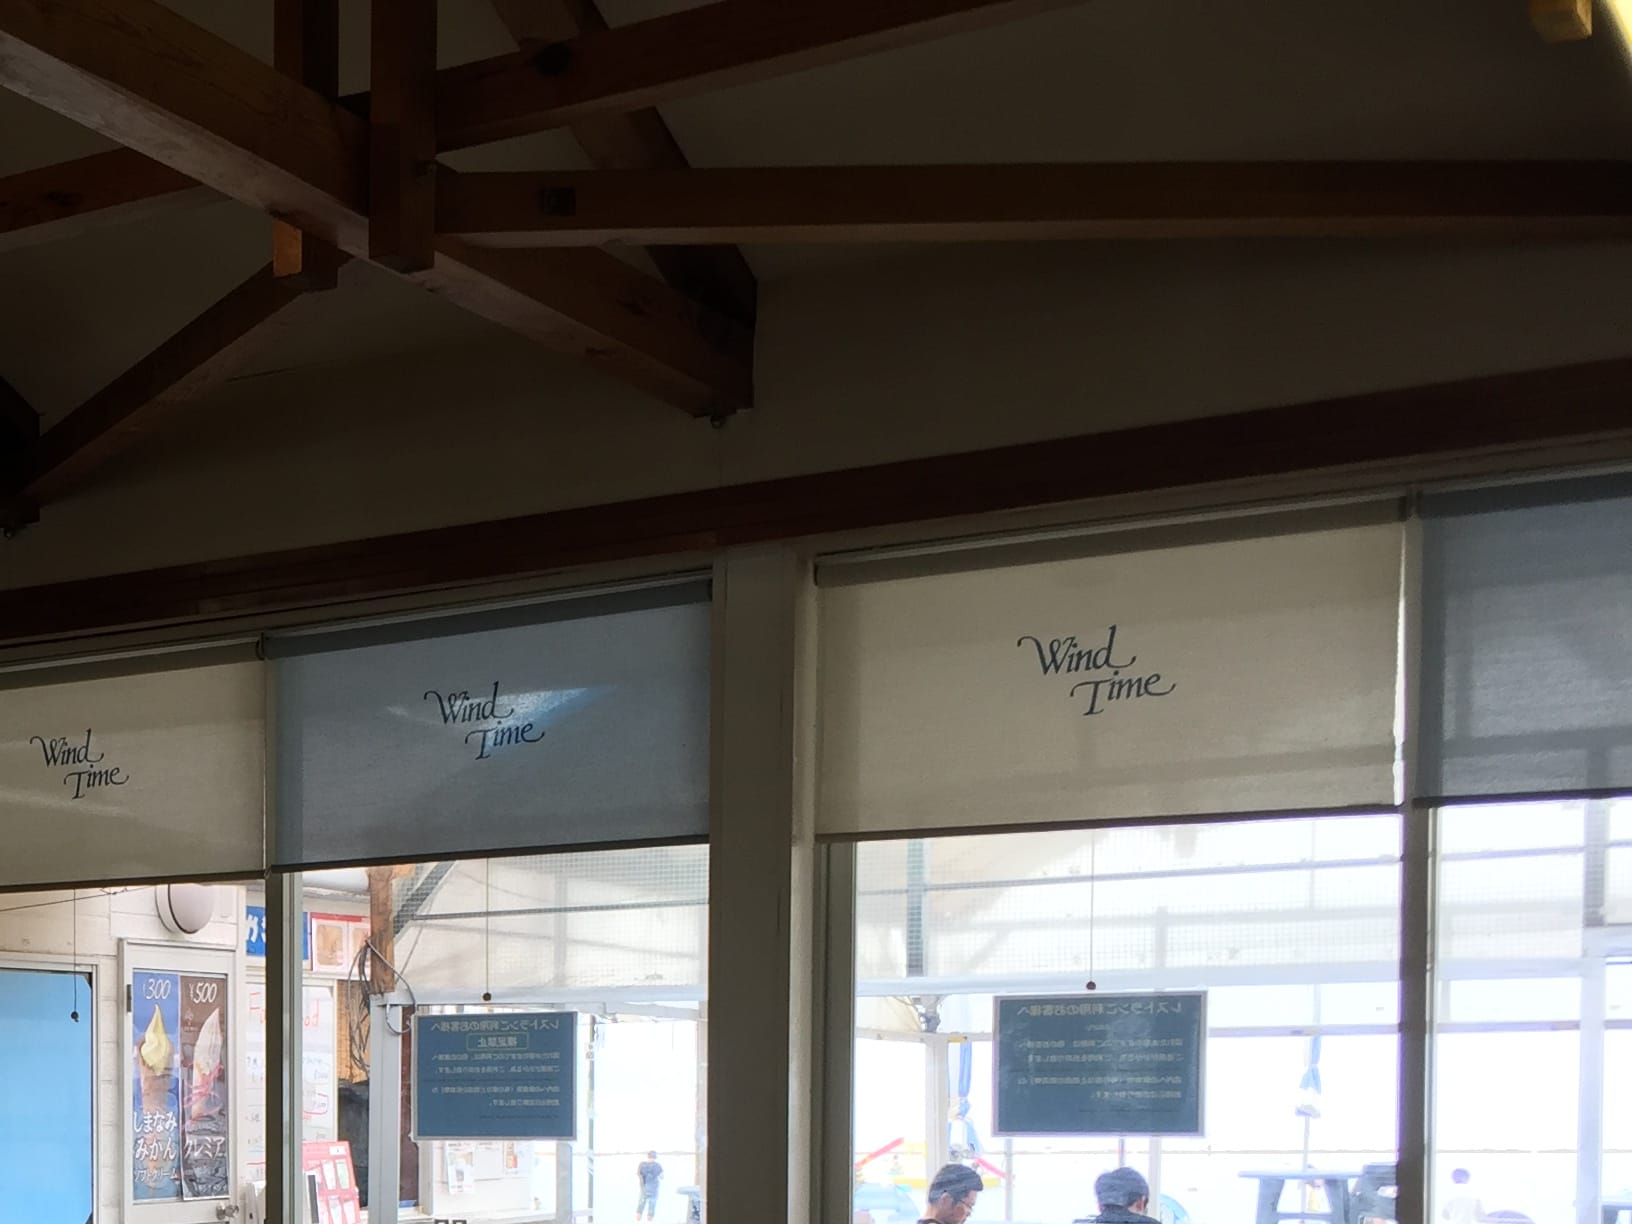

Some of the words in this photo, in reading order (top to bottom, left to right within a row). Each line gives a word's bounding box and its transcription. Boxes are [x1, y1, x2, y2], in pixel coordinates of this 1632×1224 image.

[1016, 624, 1137, 676] Wind
[423, 680, 515, 724] Wind
[1069, 669, 1177, 716] Time
[29, 728, 105, 768] Wind
[464, 720, 546, 760] Time
[63, 764, 130, 800] Time
[133, 1111, 178, 1132] しまなみ
[135, 1136, 177, 1160] みかん
[184, 1136, 226, 1160] クレミア
